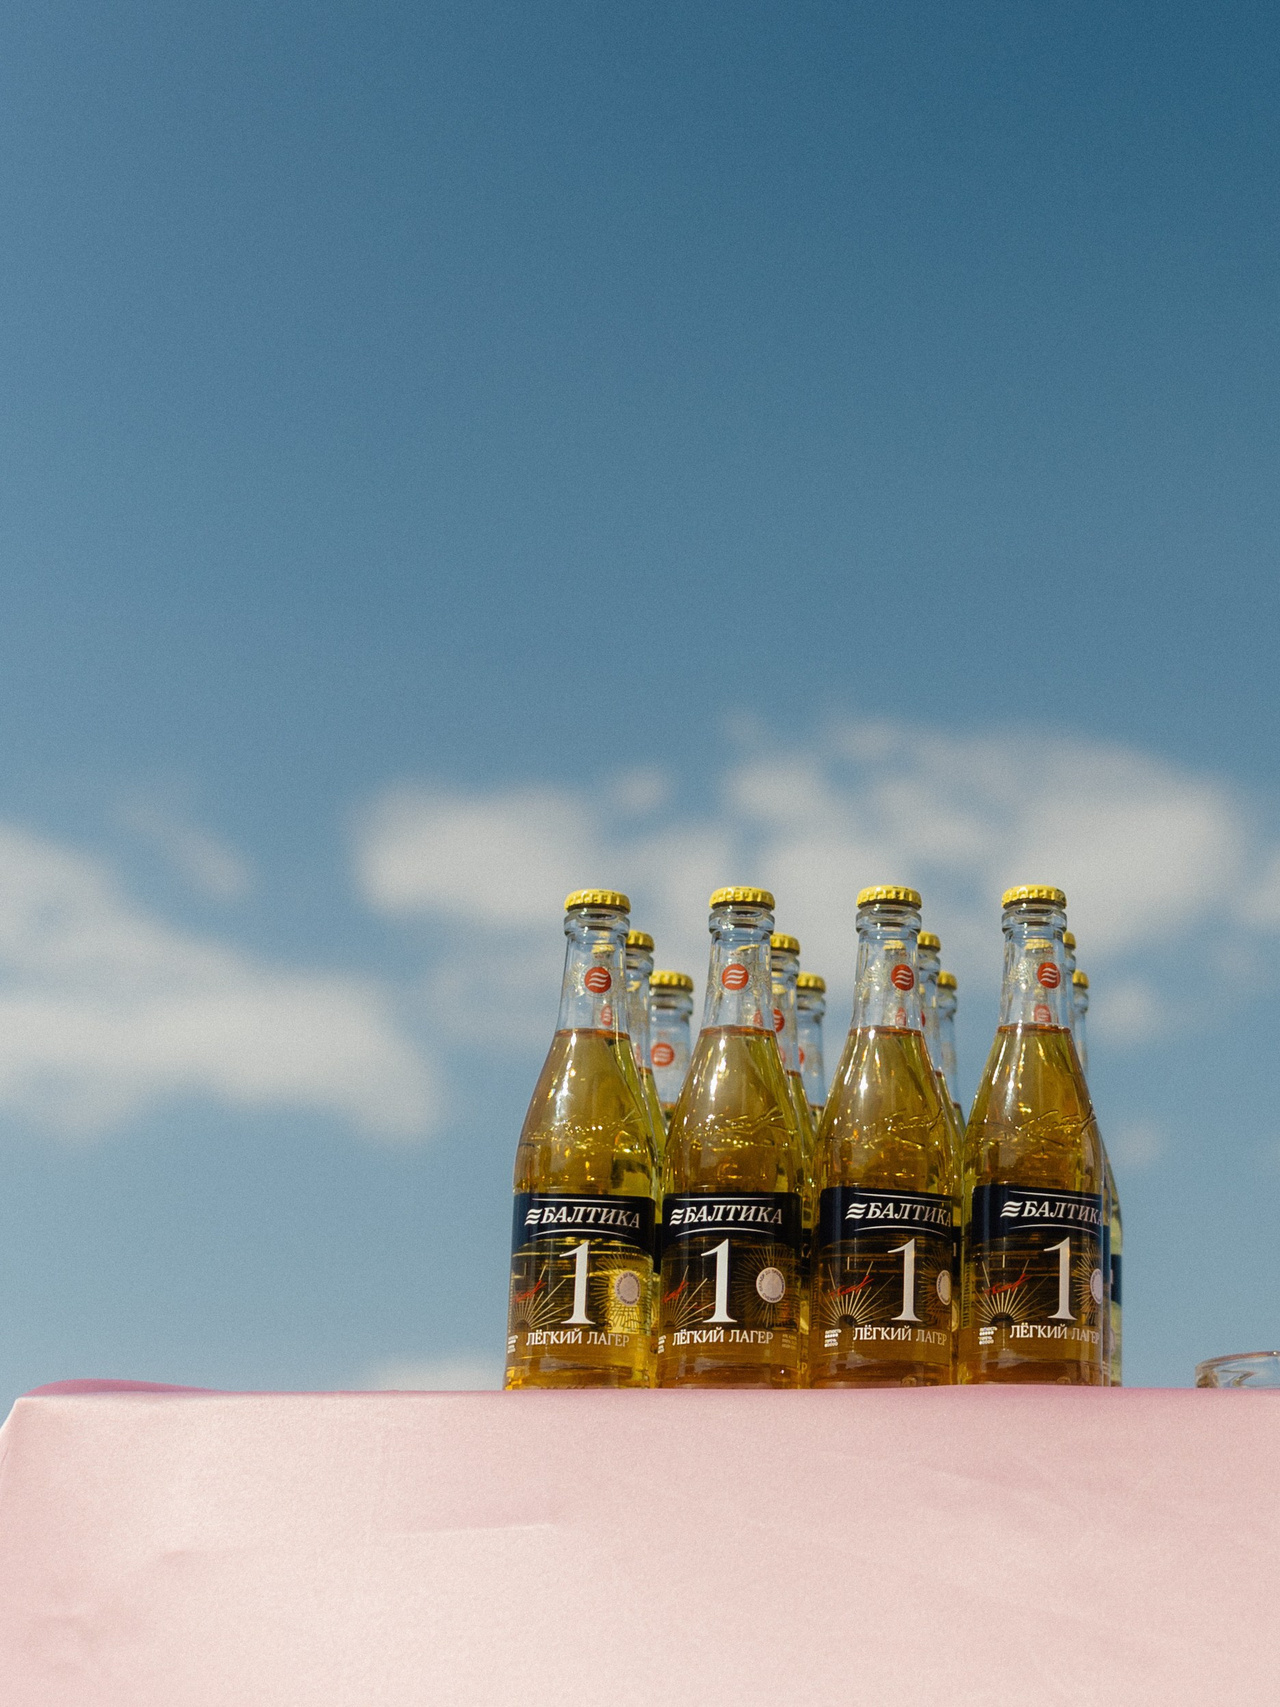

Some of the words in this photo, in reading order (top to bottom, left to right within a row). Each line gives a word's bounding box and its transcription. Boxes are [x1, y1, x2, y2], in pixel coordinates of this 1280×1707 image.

[540, 1206, 641, 1229] БАЛТИКА
[683, 1205, 783, 1225] БАЛТИКА
[866, 1202, 951, 1226] БАЛТИКА
[559, 1240, 596, 1325] 1
[701, 1238, 738, 1323] 1
[887, 1238, 923, 1322] 1
[1043, 1236, 1078, 1321] 1
[526, 1328, 582, 1346] ЛЁГКИЙ
[586, 1331, 630, 1347] ЛАГЕР
[672, 1327, 724, 1346] ЛЁГКИЙ
[728, 1330, 774, 1344] ЛАГЕР
[853, 1324, 912, 1341] ЛЁГКИЙ
[915, 1329, 947, 1346] ЛАГЕР
[1009, 1322, 1068, 1339] ЛЁГКИЙ
